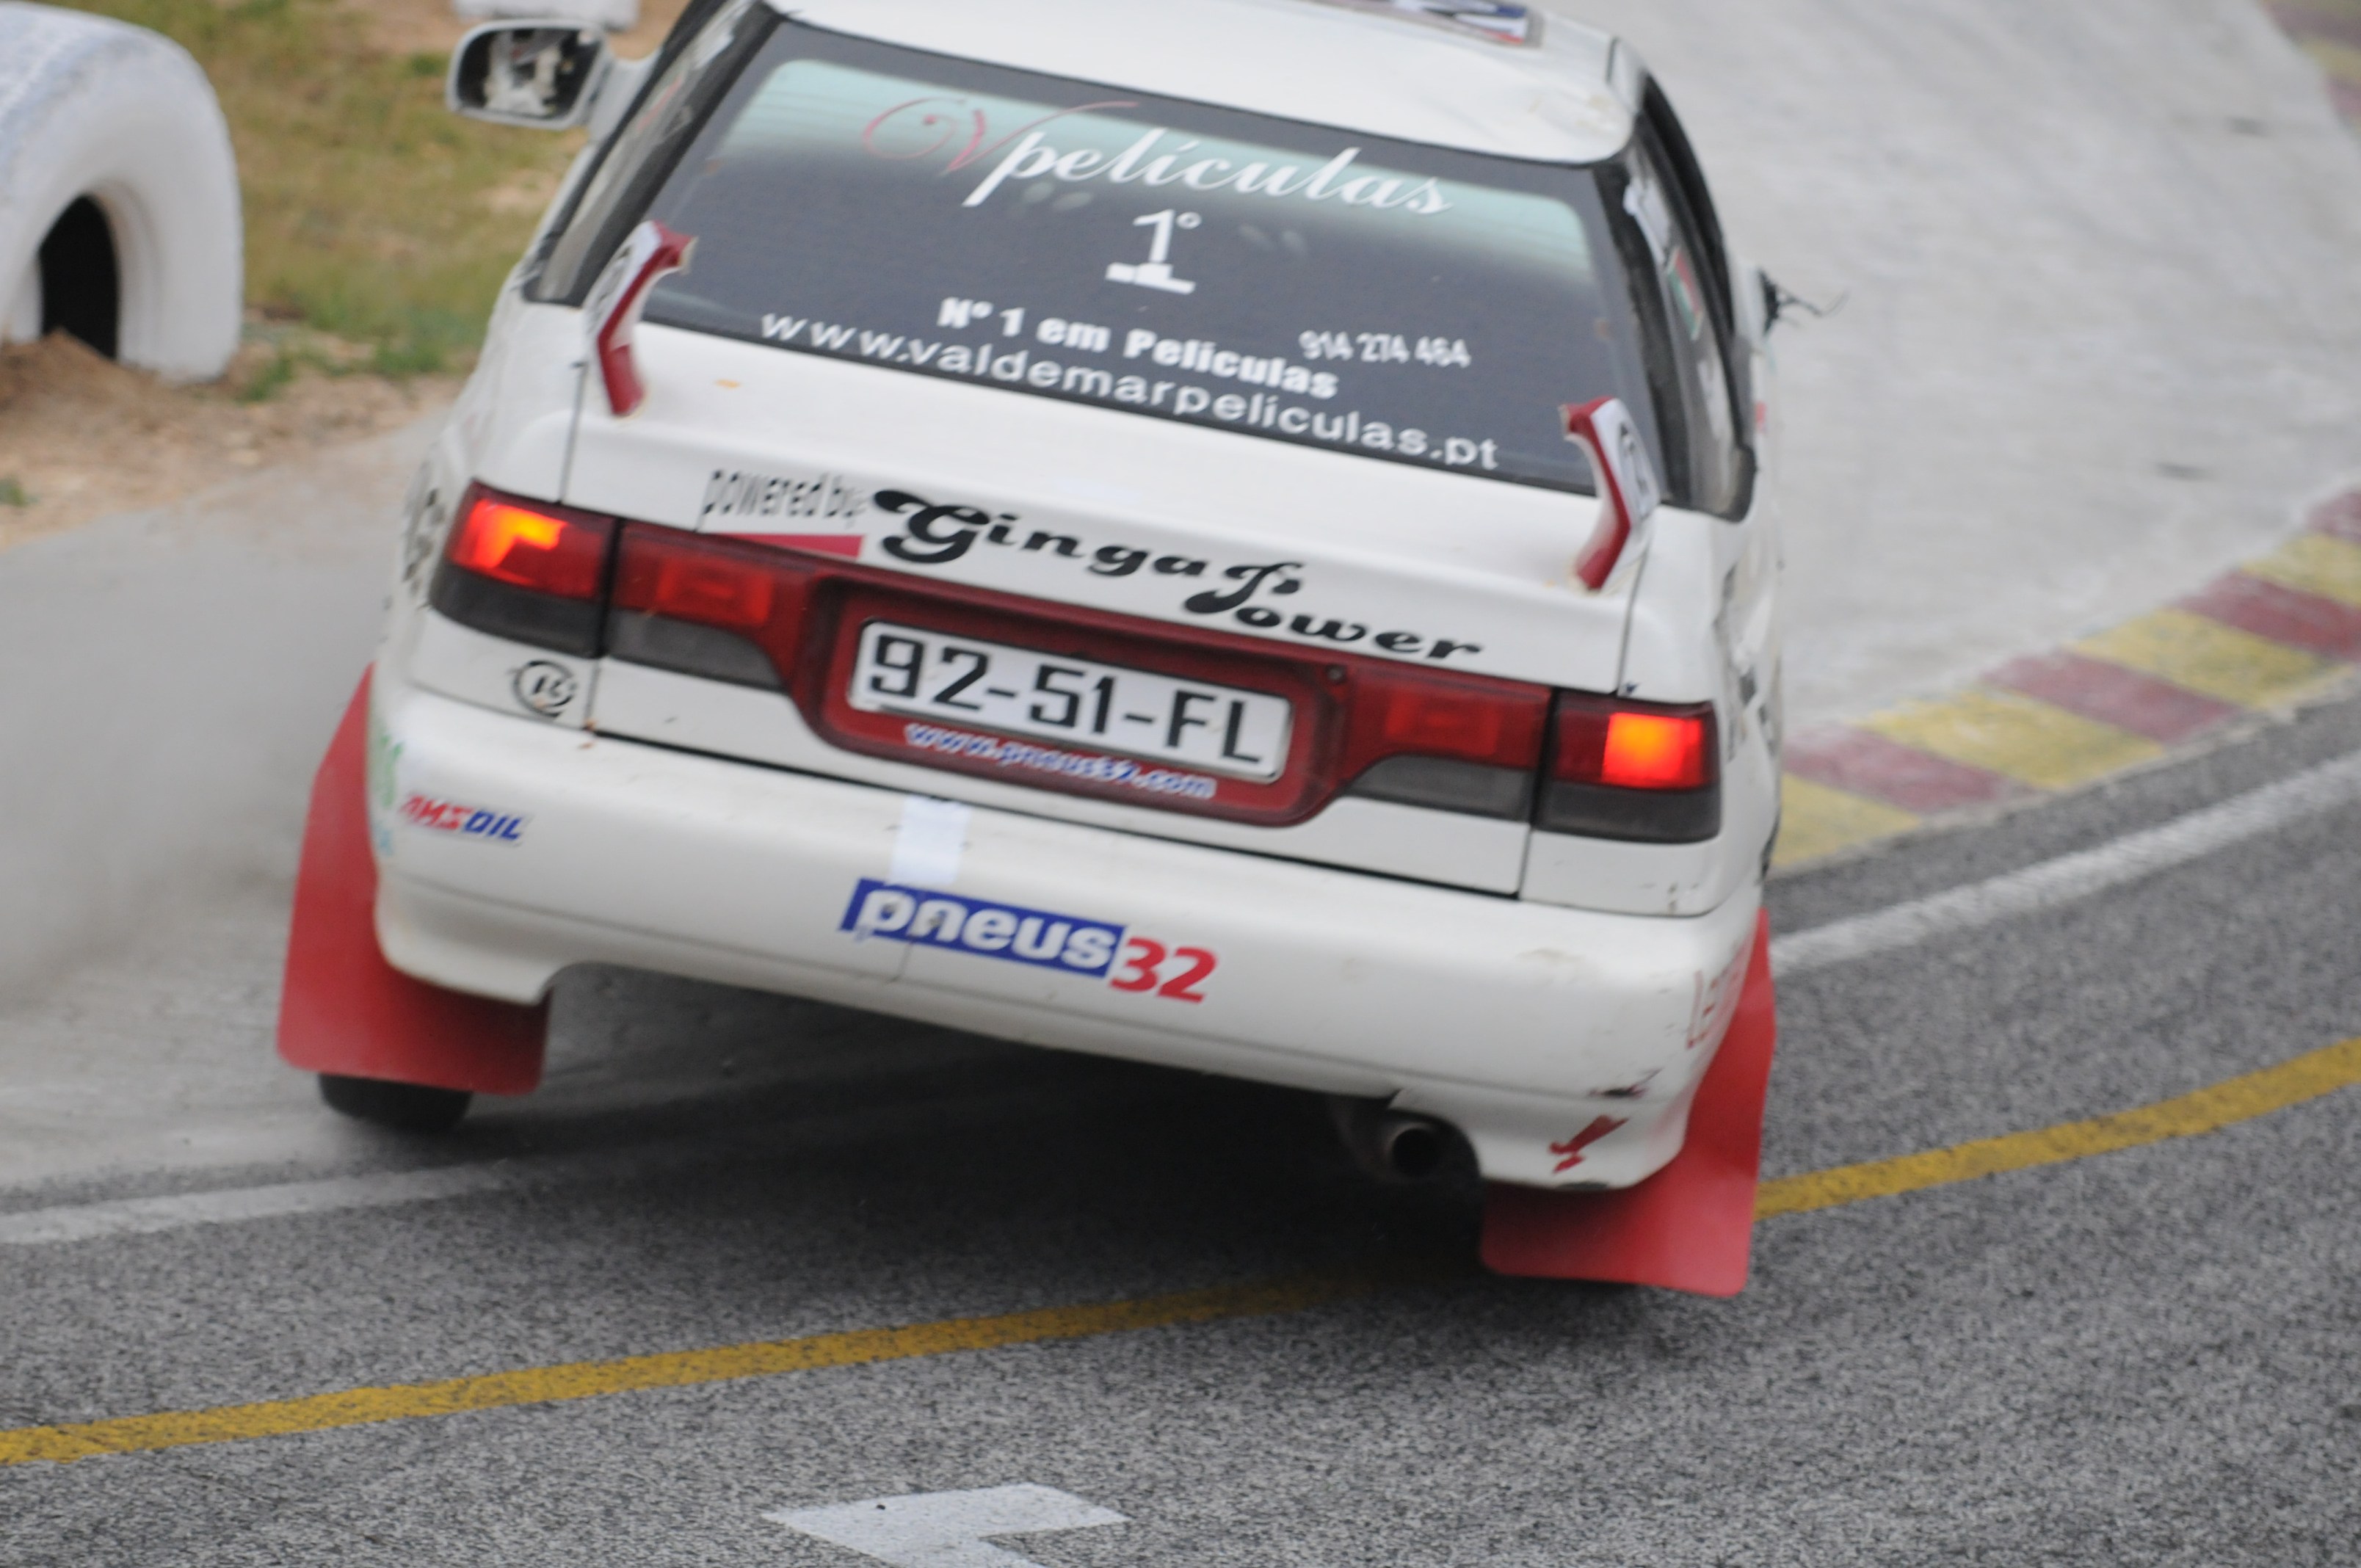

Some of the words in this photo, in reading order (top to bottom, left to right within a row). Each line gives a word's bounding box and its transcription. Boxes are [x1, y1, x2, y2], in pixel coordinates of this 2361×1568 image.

[1000, 307, 1025, 337] 1
[1036, 317, 1111, 352] em
[1298, 330, 1354, 361] 914
[1356, 332, 1410, 364] 274
[872, 489, 1213, 577] Ginga
[1182, 559, 1483, 661] Power
[869, 635, 1266, 765] 92-51-FL
[399, 794, 525, 841] AMSOIL
